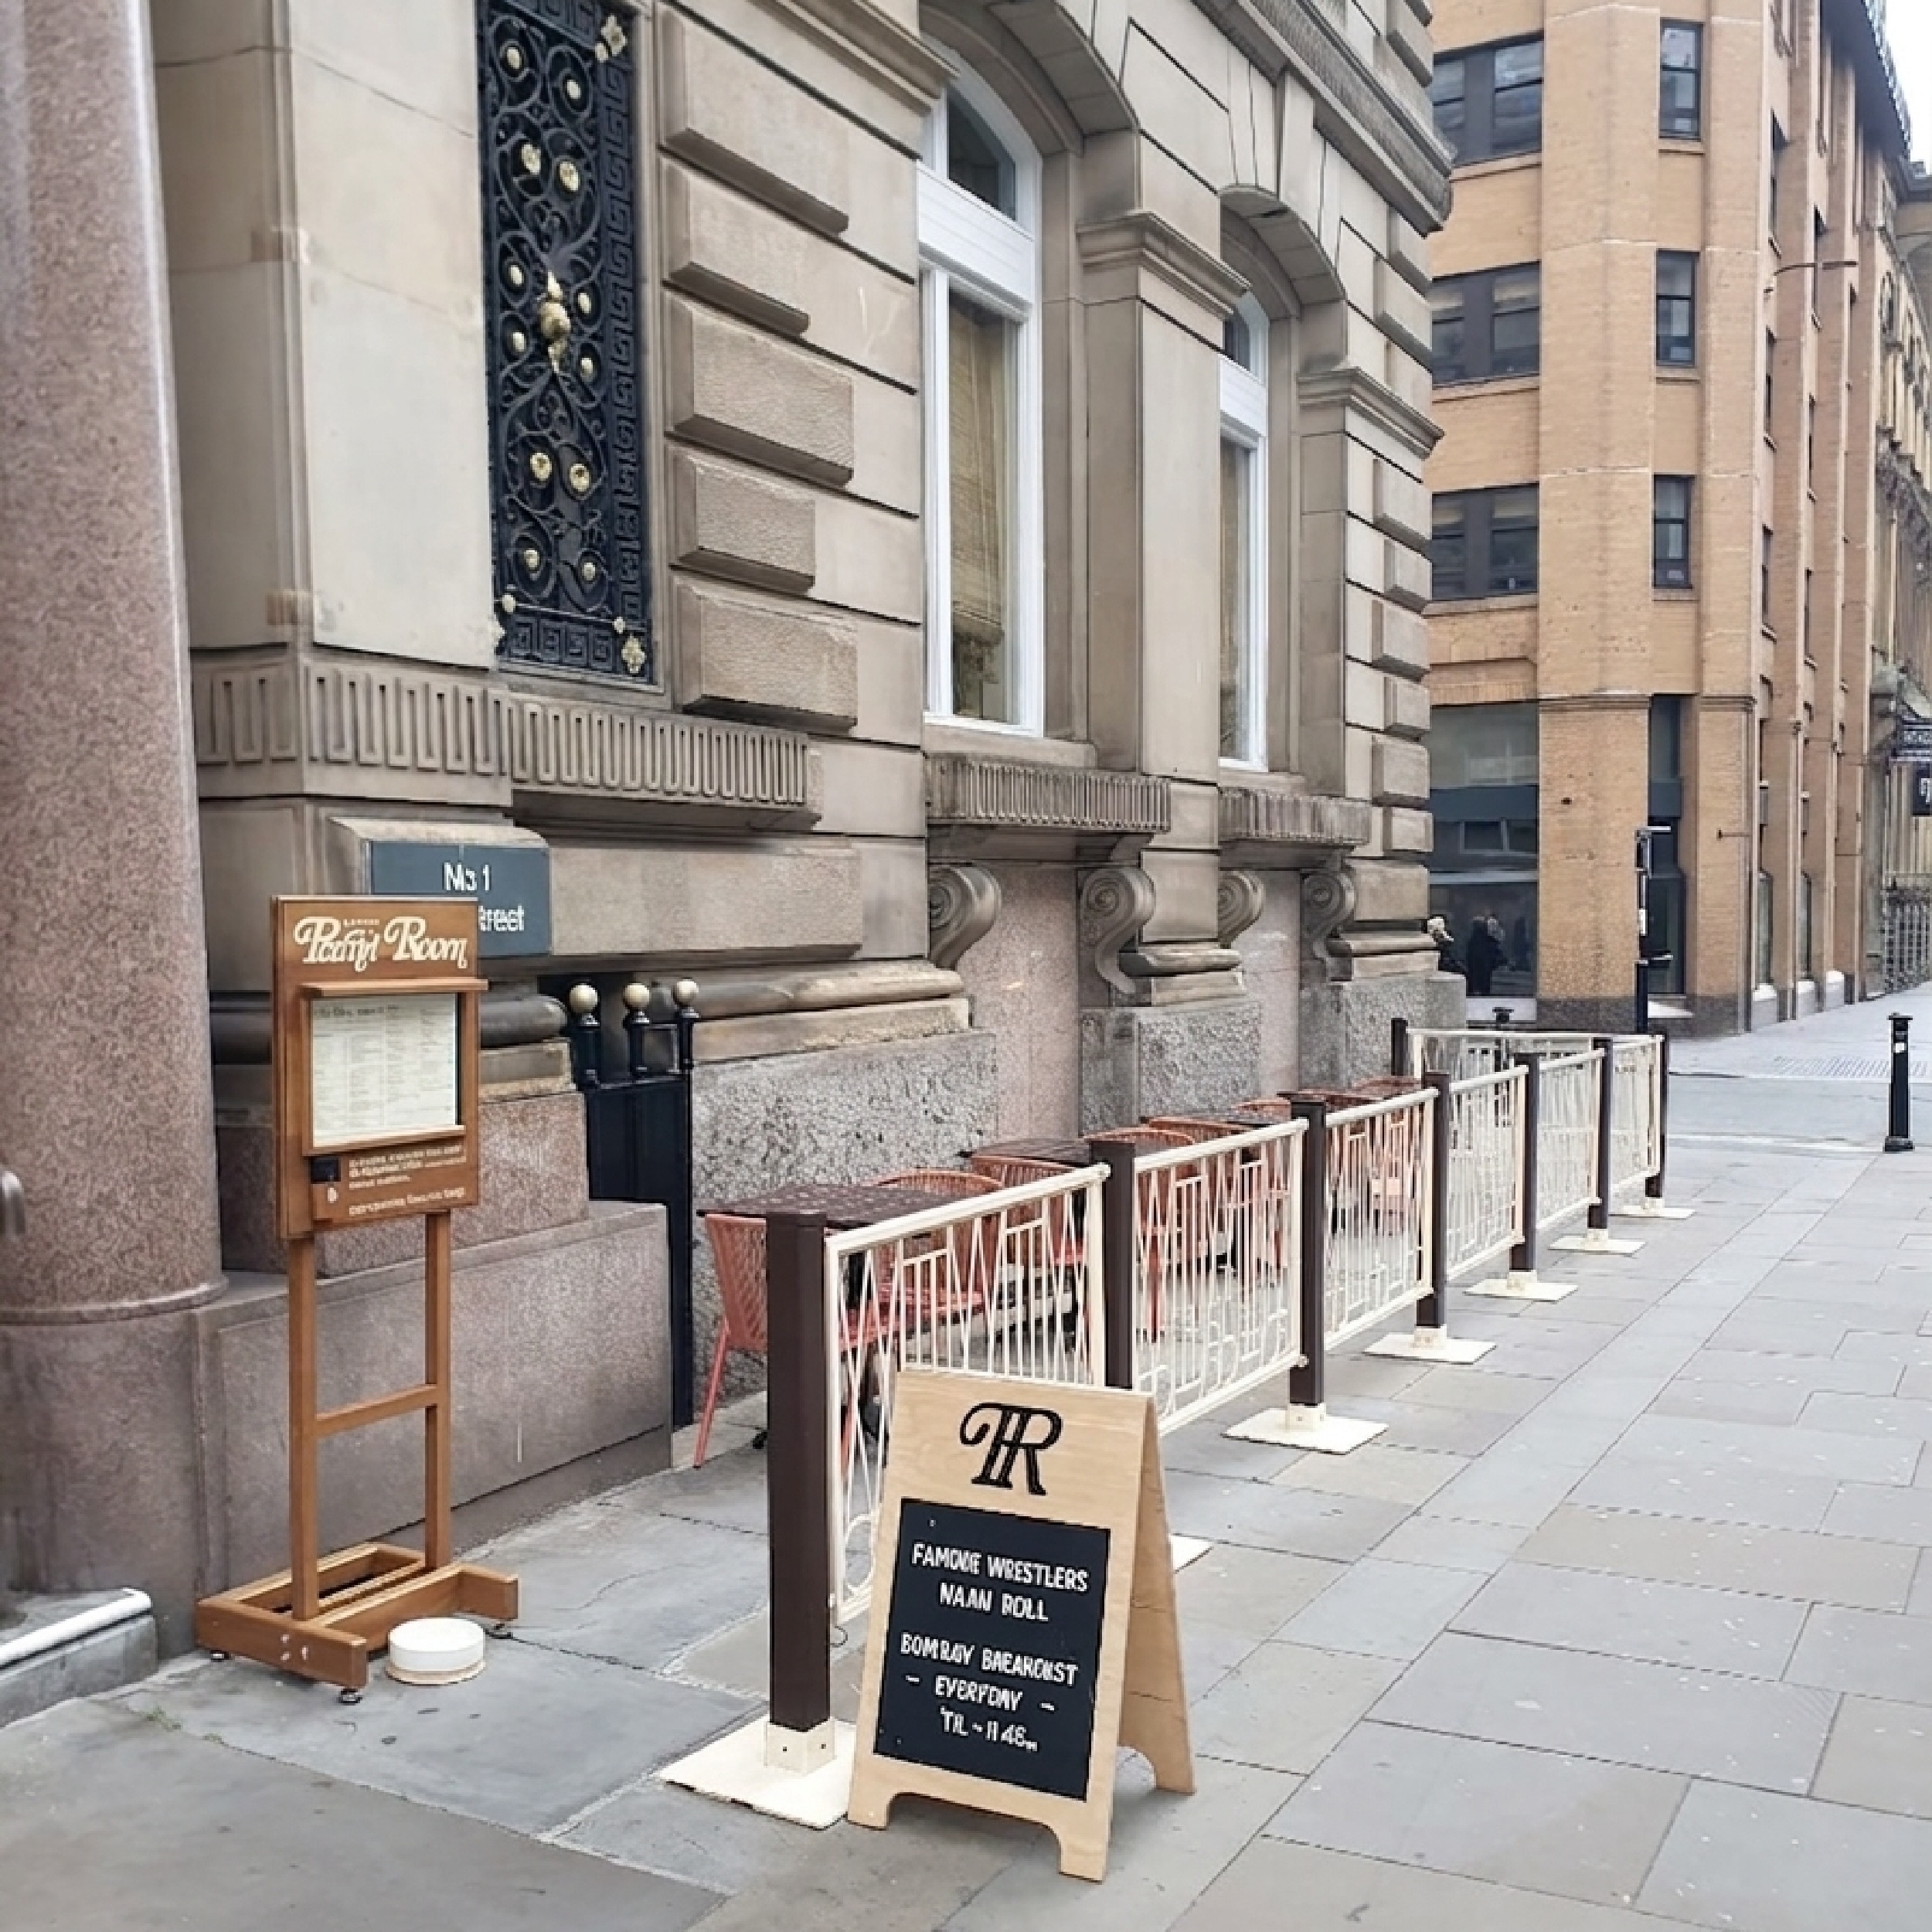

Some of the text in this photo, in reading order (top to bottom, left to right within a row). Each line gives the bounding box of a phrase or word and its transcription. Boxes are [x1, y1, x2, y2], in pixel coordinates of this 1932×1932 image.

[482, 864, 490, 891] 1
[478, 904, 525, 932] treet
[384, 916, 468, 968] Room
[987, 1554, 1088, 1592] WRESTLERS
[940, 1582, 1049, 1621] NAAN ROLL
[900, 1632, 975, 1665] BOMBAY
